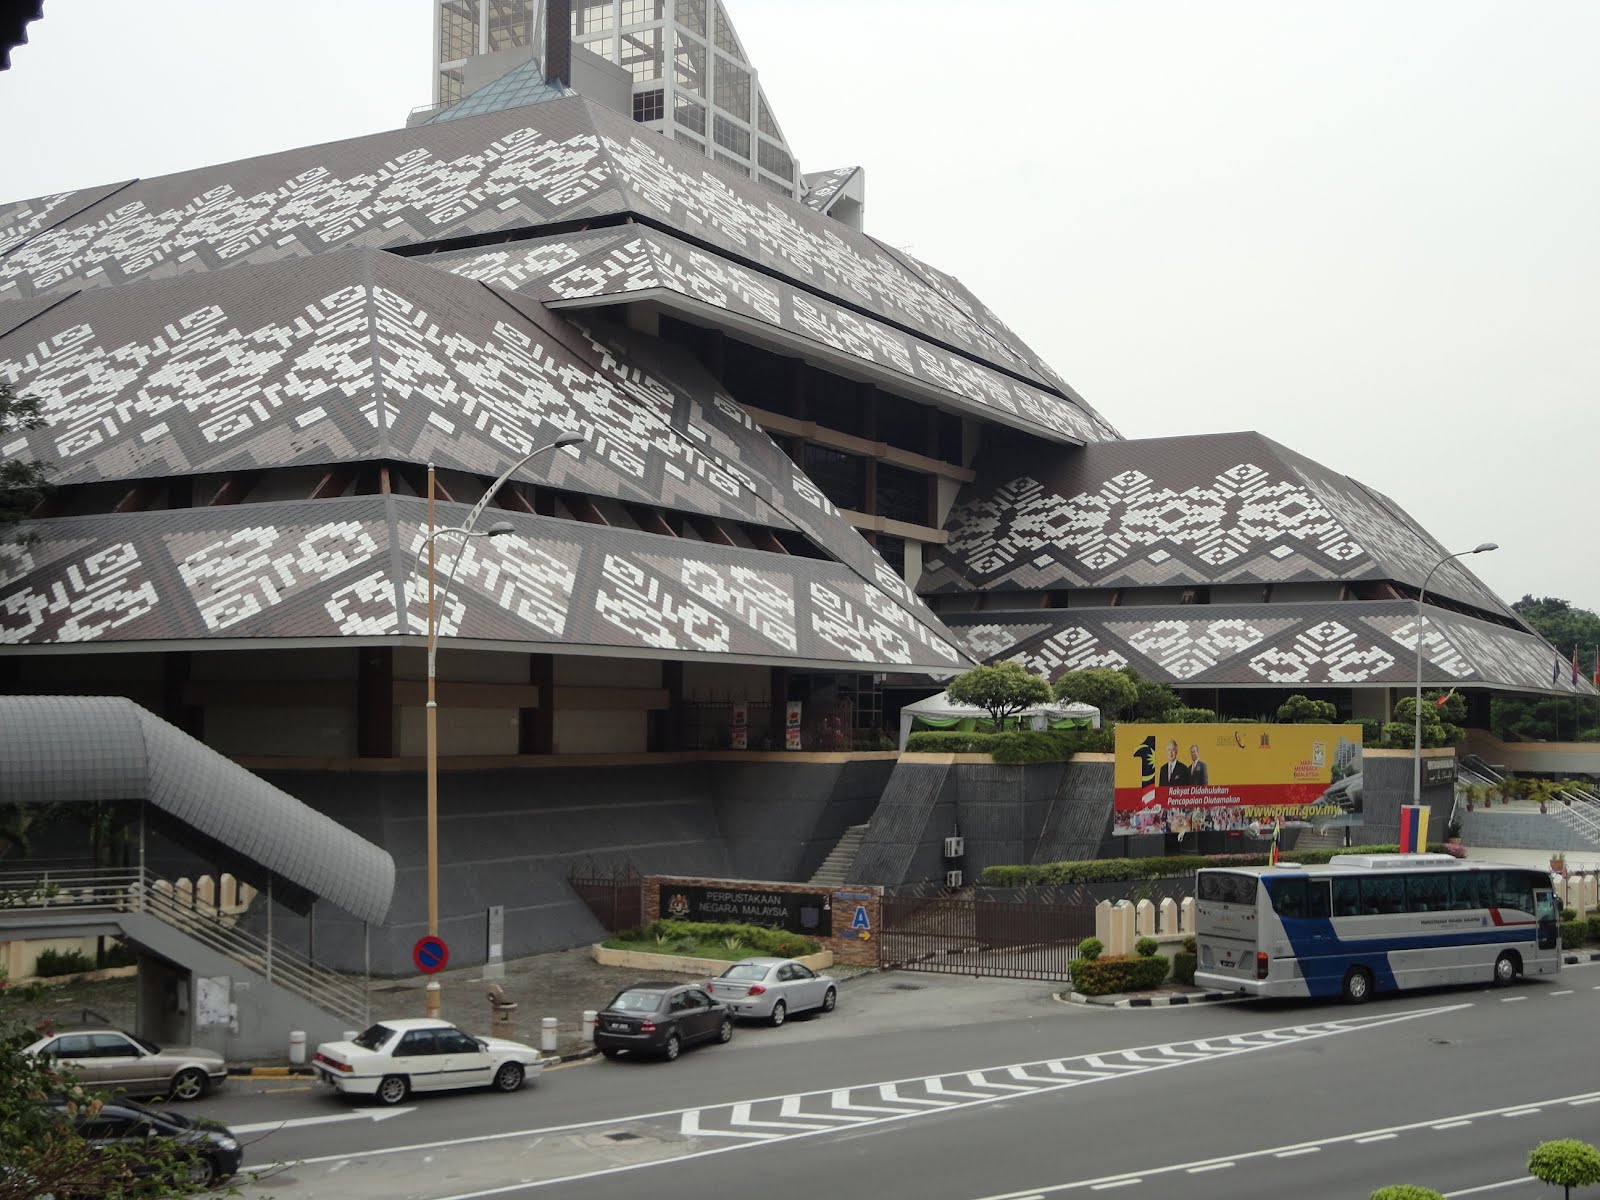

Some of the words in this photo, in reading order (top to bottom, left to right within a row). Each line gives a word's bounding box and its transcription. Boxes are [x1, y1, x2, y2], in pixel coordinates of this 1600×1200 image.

[1168, 786, 1190, 797] Rakyat
[1190, 786, 1229, 796] Didahulukan
[1167, 797, 1203, 807] Pencapaian
[1203, 796, 1241, 805] Diutamakan
[1243, 803, 1342, 819] www.pnm.gov.my
[706, 891, 782, 905] PERPUSTAKAAN
[699, 902, 738, 914] NEGARA
[742, 905, 789, 917] MALAYSIA
[851, 905, 871, 930] A
